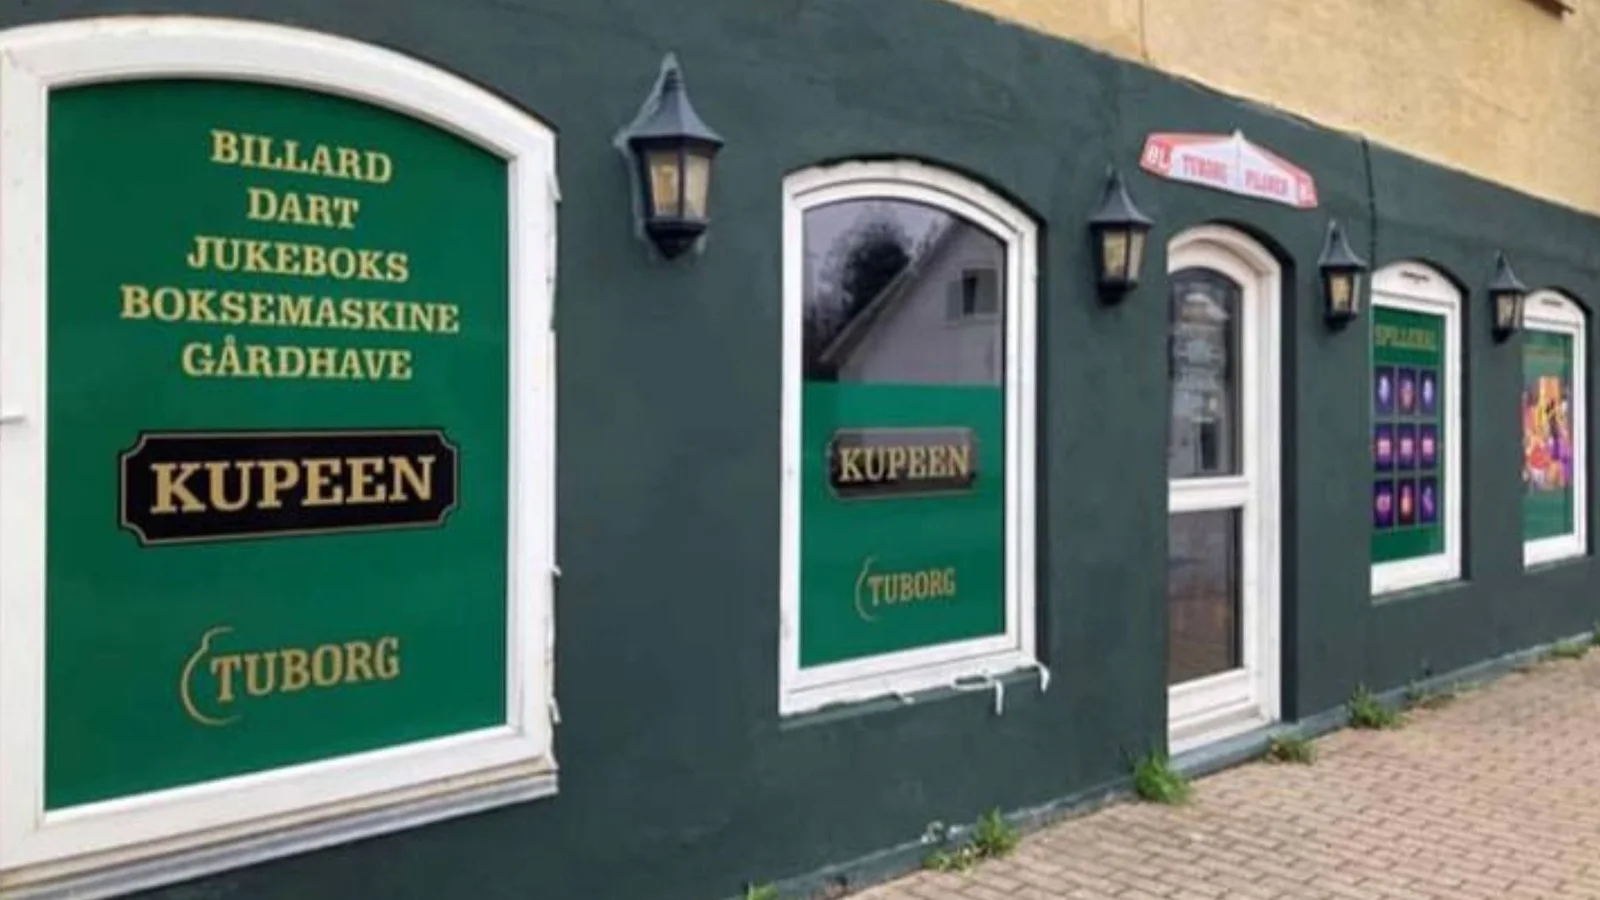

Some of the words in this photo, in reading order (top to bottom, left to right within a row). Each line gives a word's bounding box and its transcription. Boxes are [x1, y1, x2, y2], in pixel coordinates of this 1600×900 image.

[210, 129, 392, 184] BILLARD
[247, 187, 360, 229] DART
[187, 235, 410, 283] JUKEBOKS
[120, 283, 460, 334] BOKSEMASKINE
[182, 334, 413, 381] GÅRDHAVE
[150, 454, 436, 515] KUPEEN
[838, 444, 970, 483] KUPEEN
[867, 566, 957, 607] TUBORG
[210, 636, 400, 702] TUBORG
